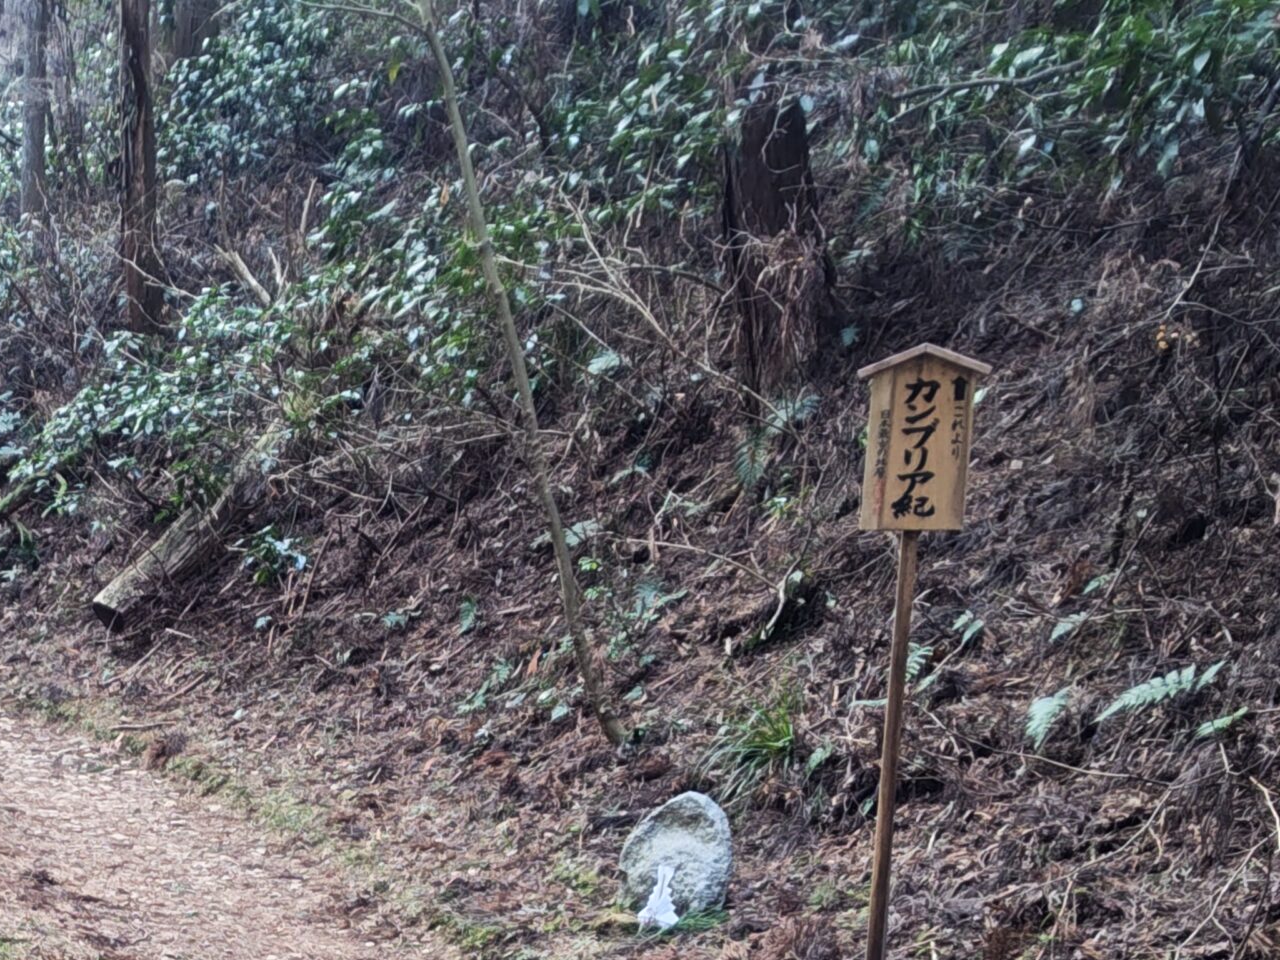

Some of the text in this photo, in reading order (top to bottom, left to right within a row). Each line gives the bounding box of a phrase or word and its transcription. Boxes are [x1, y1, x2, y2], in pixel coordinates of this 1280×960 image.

[891, 377, 941, 519] カンブリア紀
[951, 406, 965, 461] これより
